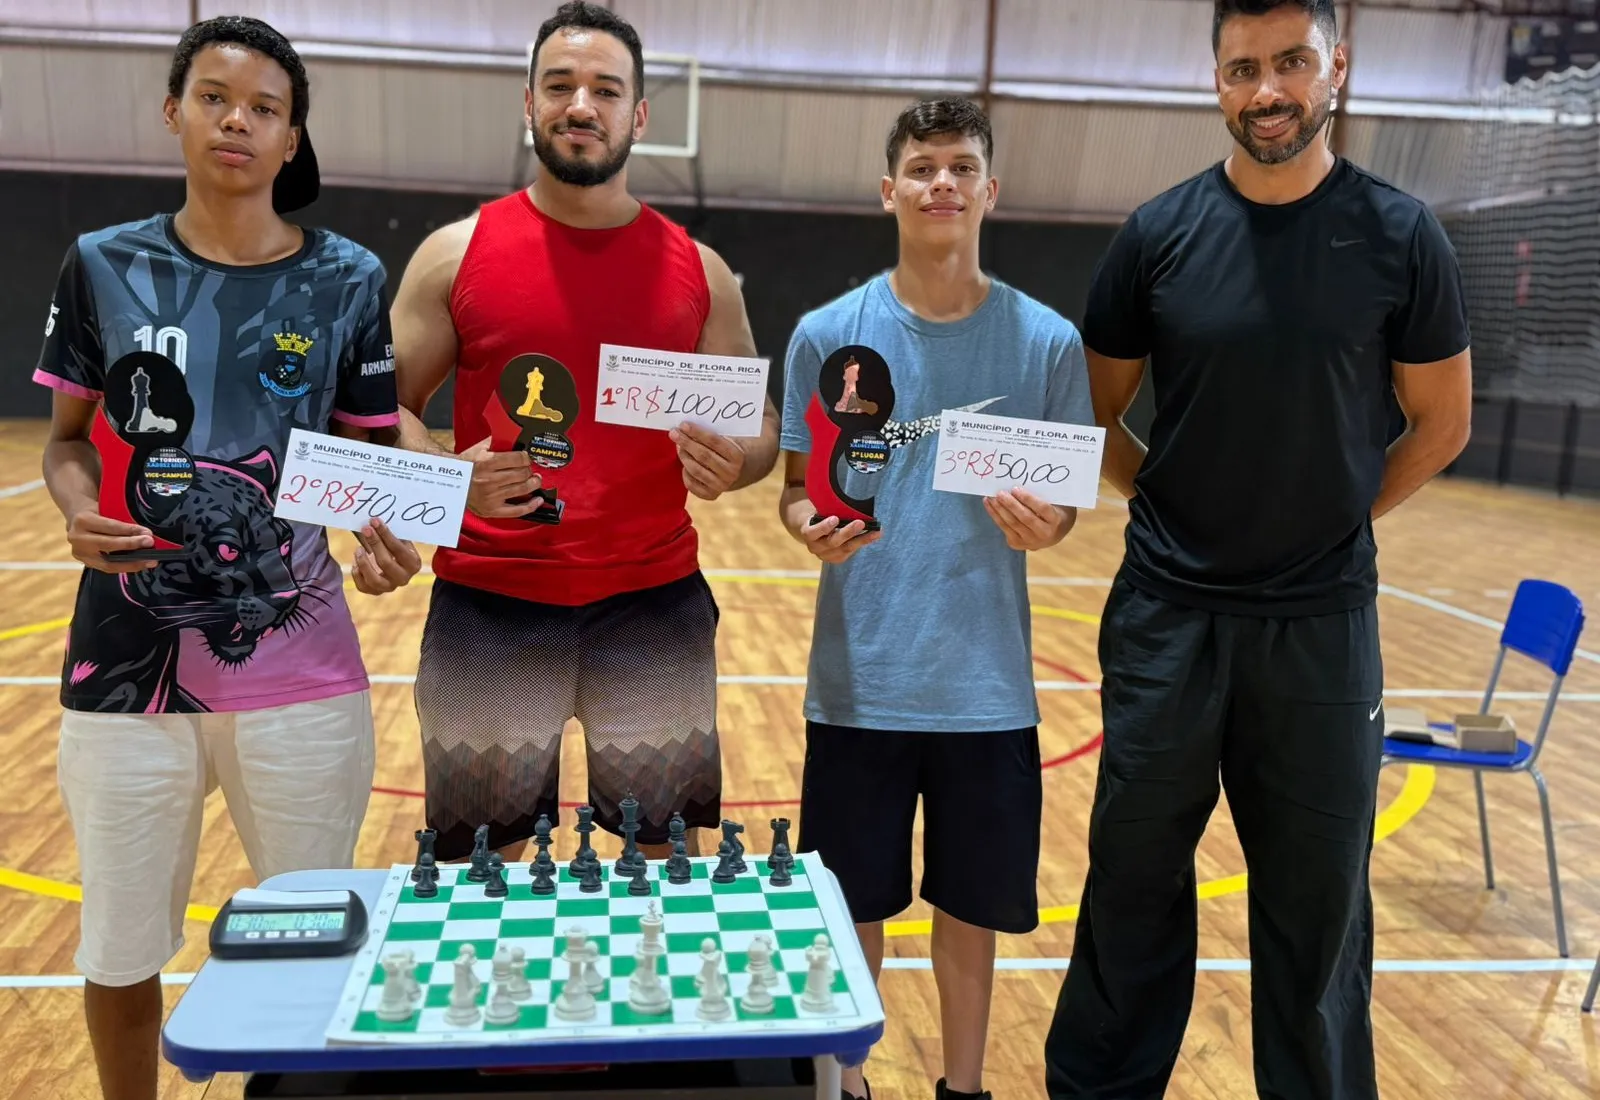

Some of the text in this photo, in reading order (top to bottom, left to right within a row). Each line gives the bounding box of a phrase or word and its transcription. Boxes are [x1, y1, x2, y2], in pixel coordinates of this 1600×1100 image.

[133, 325, 188, 376] 10
[622, 356, 761, 374] MUNICÍPIO DE FLORA RICA
[961, 421, 1097, 443] MUNICÍPIO DE FLORA RICA
[313, 443, 372, 460] MUNICÍPIO
[377, 455, 392, 464] DE
[398, 459, 433, 472] FLORA
[439, 466, 463, 478] RICA
[530, 446, 568, 459] CAMPEÃO
[860, 452, 885, 460] LUGAR
